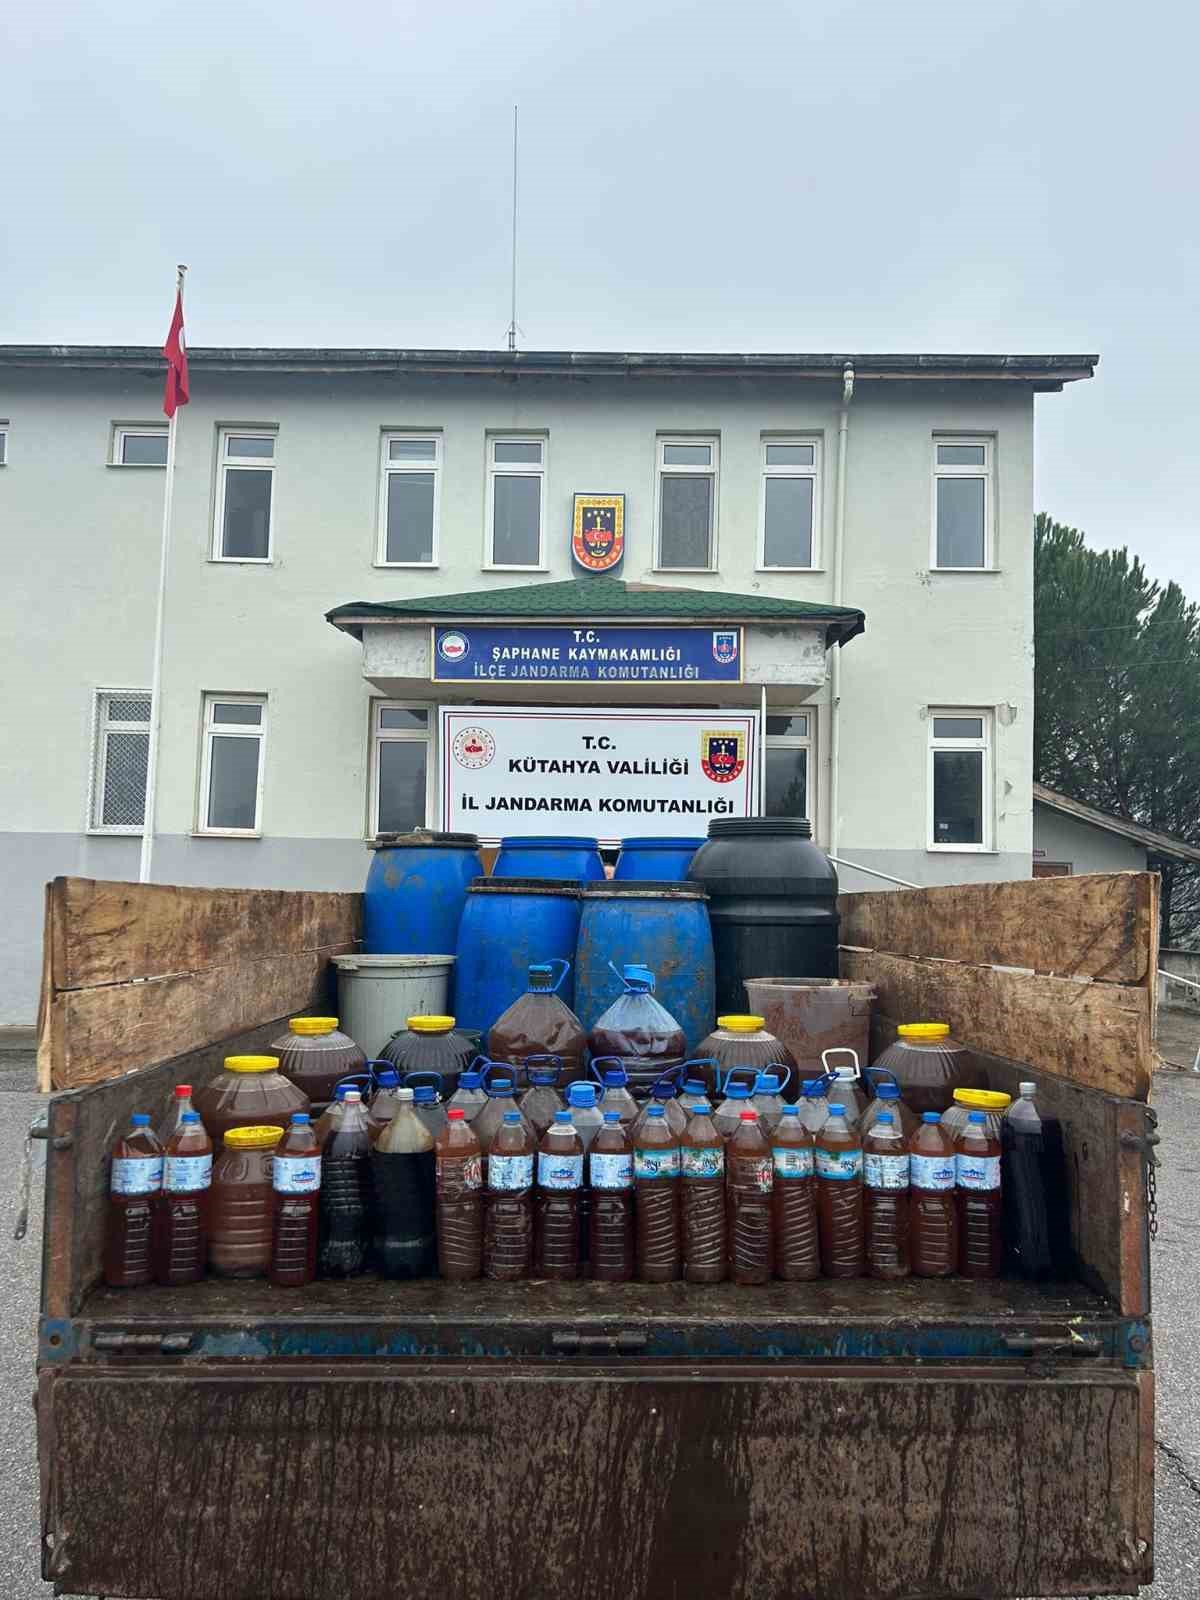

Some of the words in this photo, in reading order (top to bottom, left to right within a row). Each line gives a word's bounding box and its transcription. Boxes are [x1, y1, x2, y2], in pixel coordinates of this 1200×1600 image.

[573, 630, 600, 643] T.C.
[492, 647, 560, 662] ŞAPHANE
[568, 646, 681, 661] KAYMAKAMLIĞI
[474, 662, 506, 679] İLÇE
[511, 664, 590, 678] JANDARMA
[598, 663, 699, 679] KOMUTANLIĞI
[582, 736, 616, 750] T.C.
[508, 756, 601, 774] KÜTAHYA
[607, 758, 689, 775] VALİLİĞİ
[462, 793, 479, 810] İL
[485, 797, 593, 811] JANDARMA
[599, 797, 733, 813] KOMUTANLIĞI
